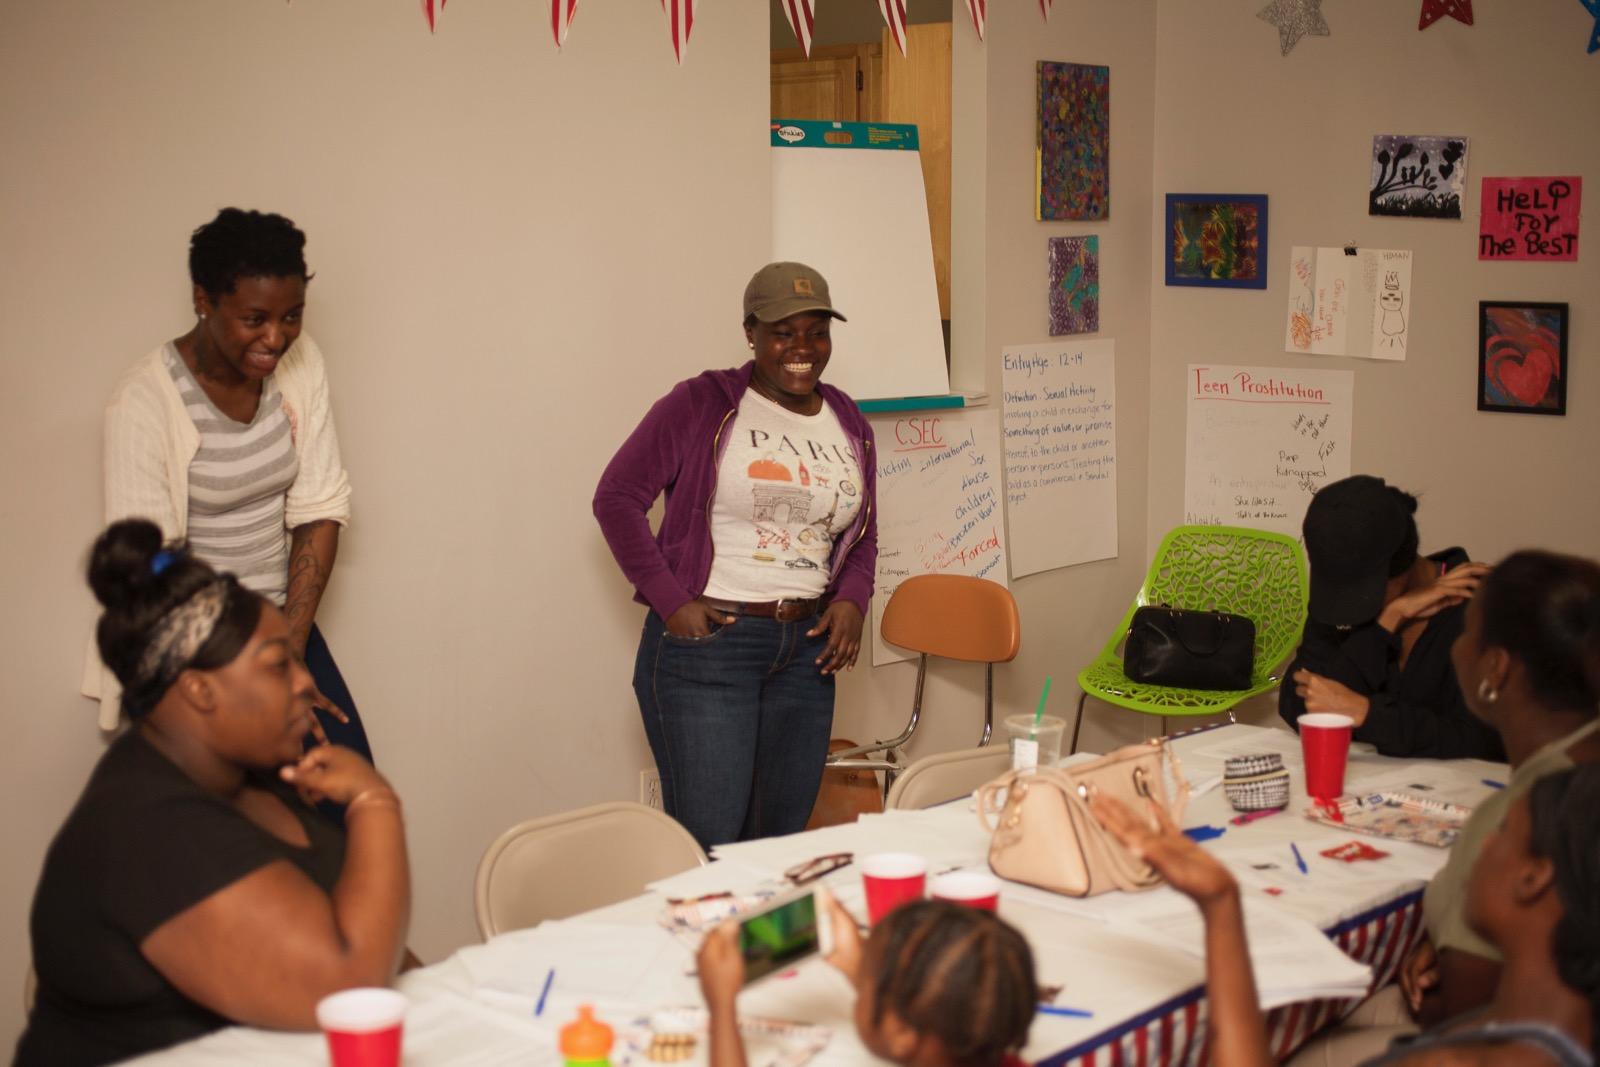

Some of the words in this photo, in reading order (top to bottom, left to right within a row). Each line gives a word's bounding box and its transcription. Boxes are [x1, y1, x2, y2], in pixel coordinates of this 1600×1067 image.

[1480, 234, 1515, 256] The
[1193, 368, 1229, 394] Teen
[1233, 371, 1323, 400] Prostitution
[895, 417, 943, 446] CSEC
[749, 429, 858, 465] PARIS
